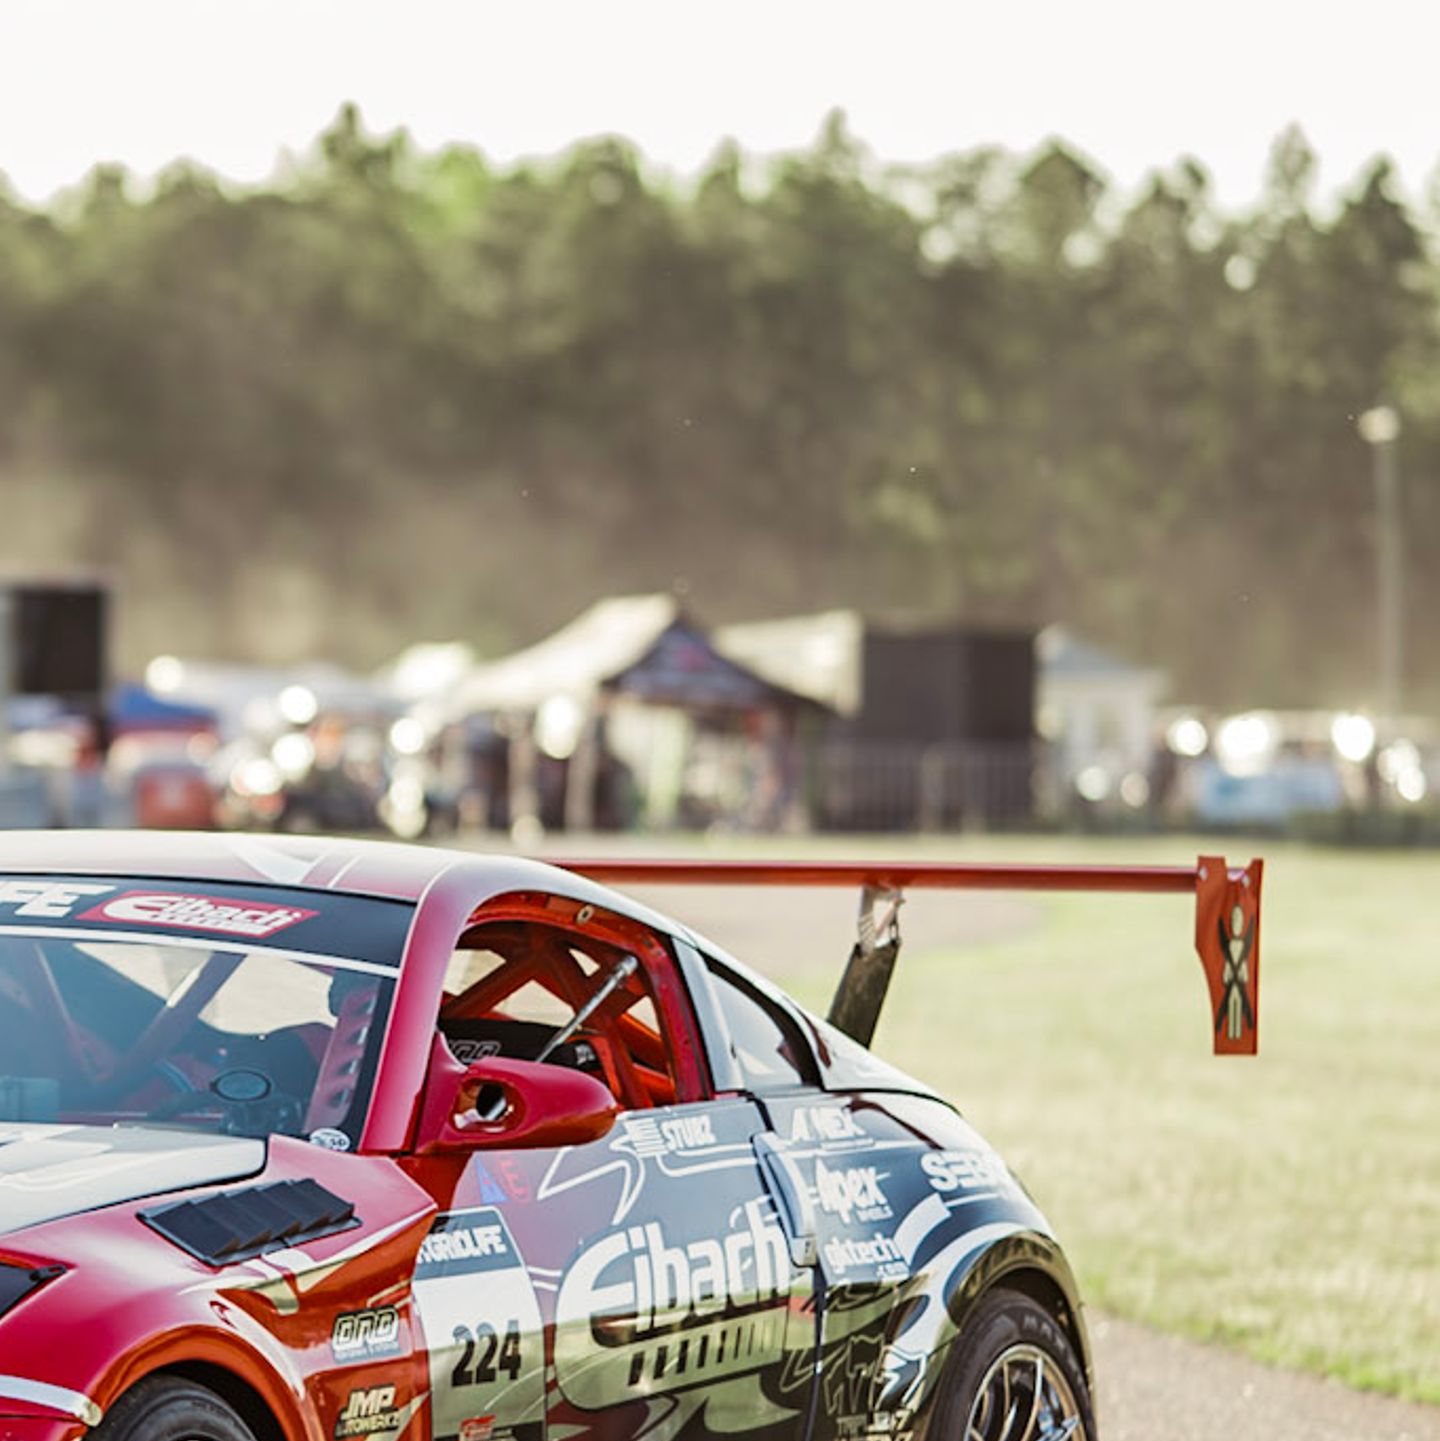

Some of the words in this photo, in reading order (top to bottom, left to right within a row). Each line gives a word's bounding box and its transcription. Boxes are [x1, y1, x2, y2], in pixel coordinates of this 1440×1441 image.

[104, 895, 301, 934] Eibach
[554, 1194, 791, 1345] Eibach
[451, 1319, 522, 1386] 224
[341, 1386, 396, 1419] JMP
